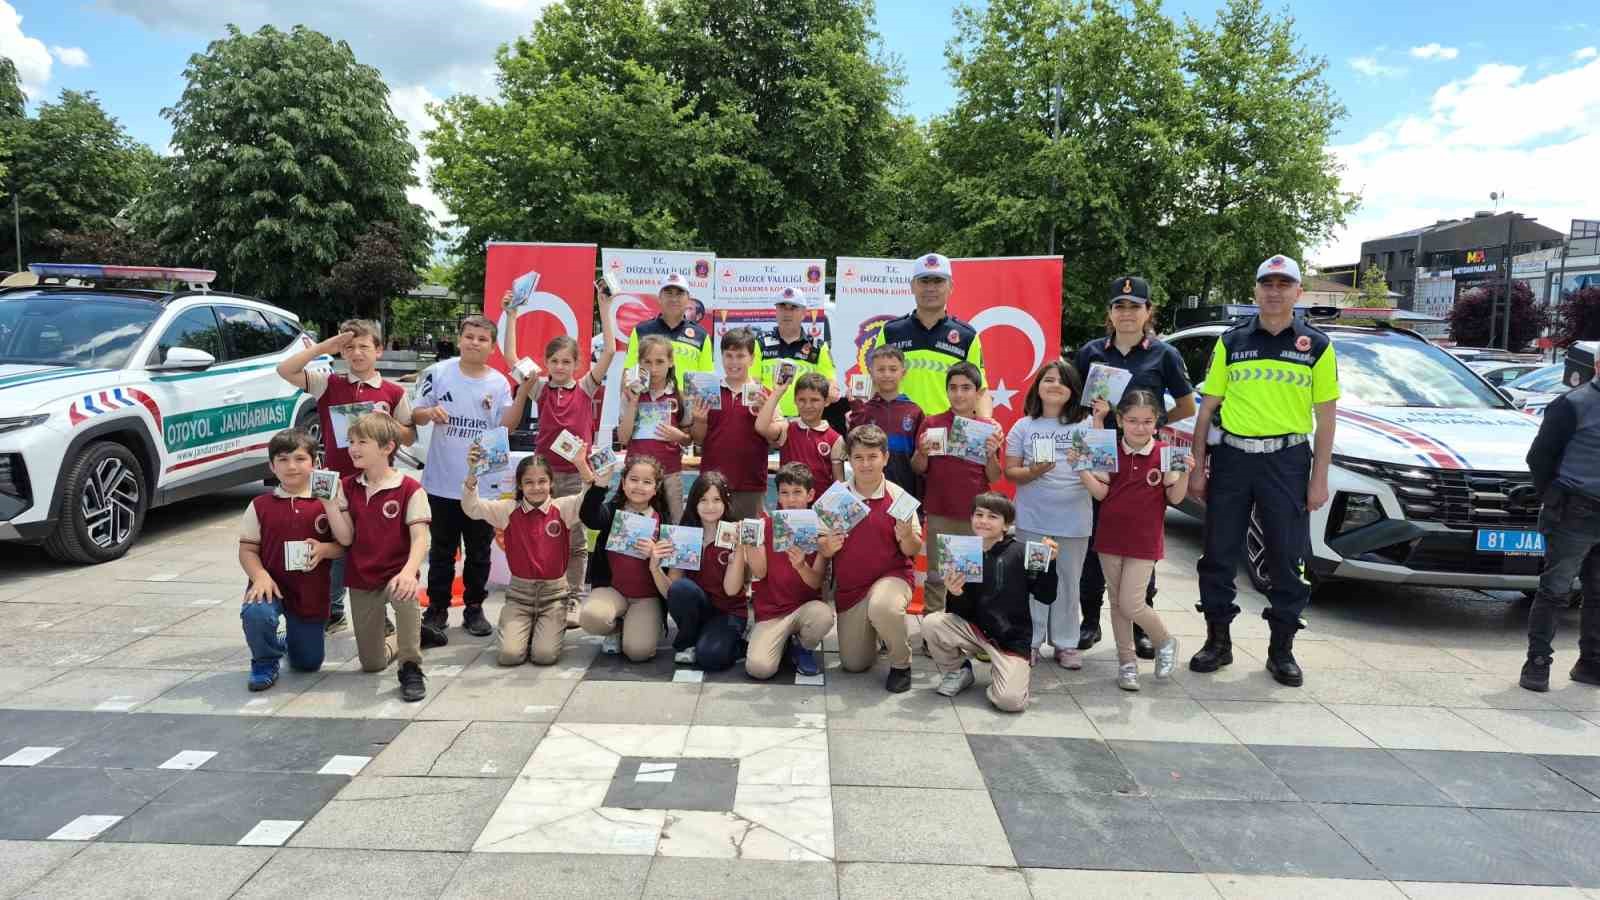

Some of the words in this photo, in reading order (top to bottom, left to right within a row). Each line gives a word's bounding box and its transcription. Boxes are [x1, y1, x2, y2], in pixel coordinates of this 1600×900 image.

[652, 256, 666, 265] T.C.
[168, 419, 213, 444] OTOYOL
[221, 405, 286, 433] JANDARMASI
[1487, 531, 1505, 549] 81
